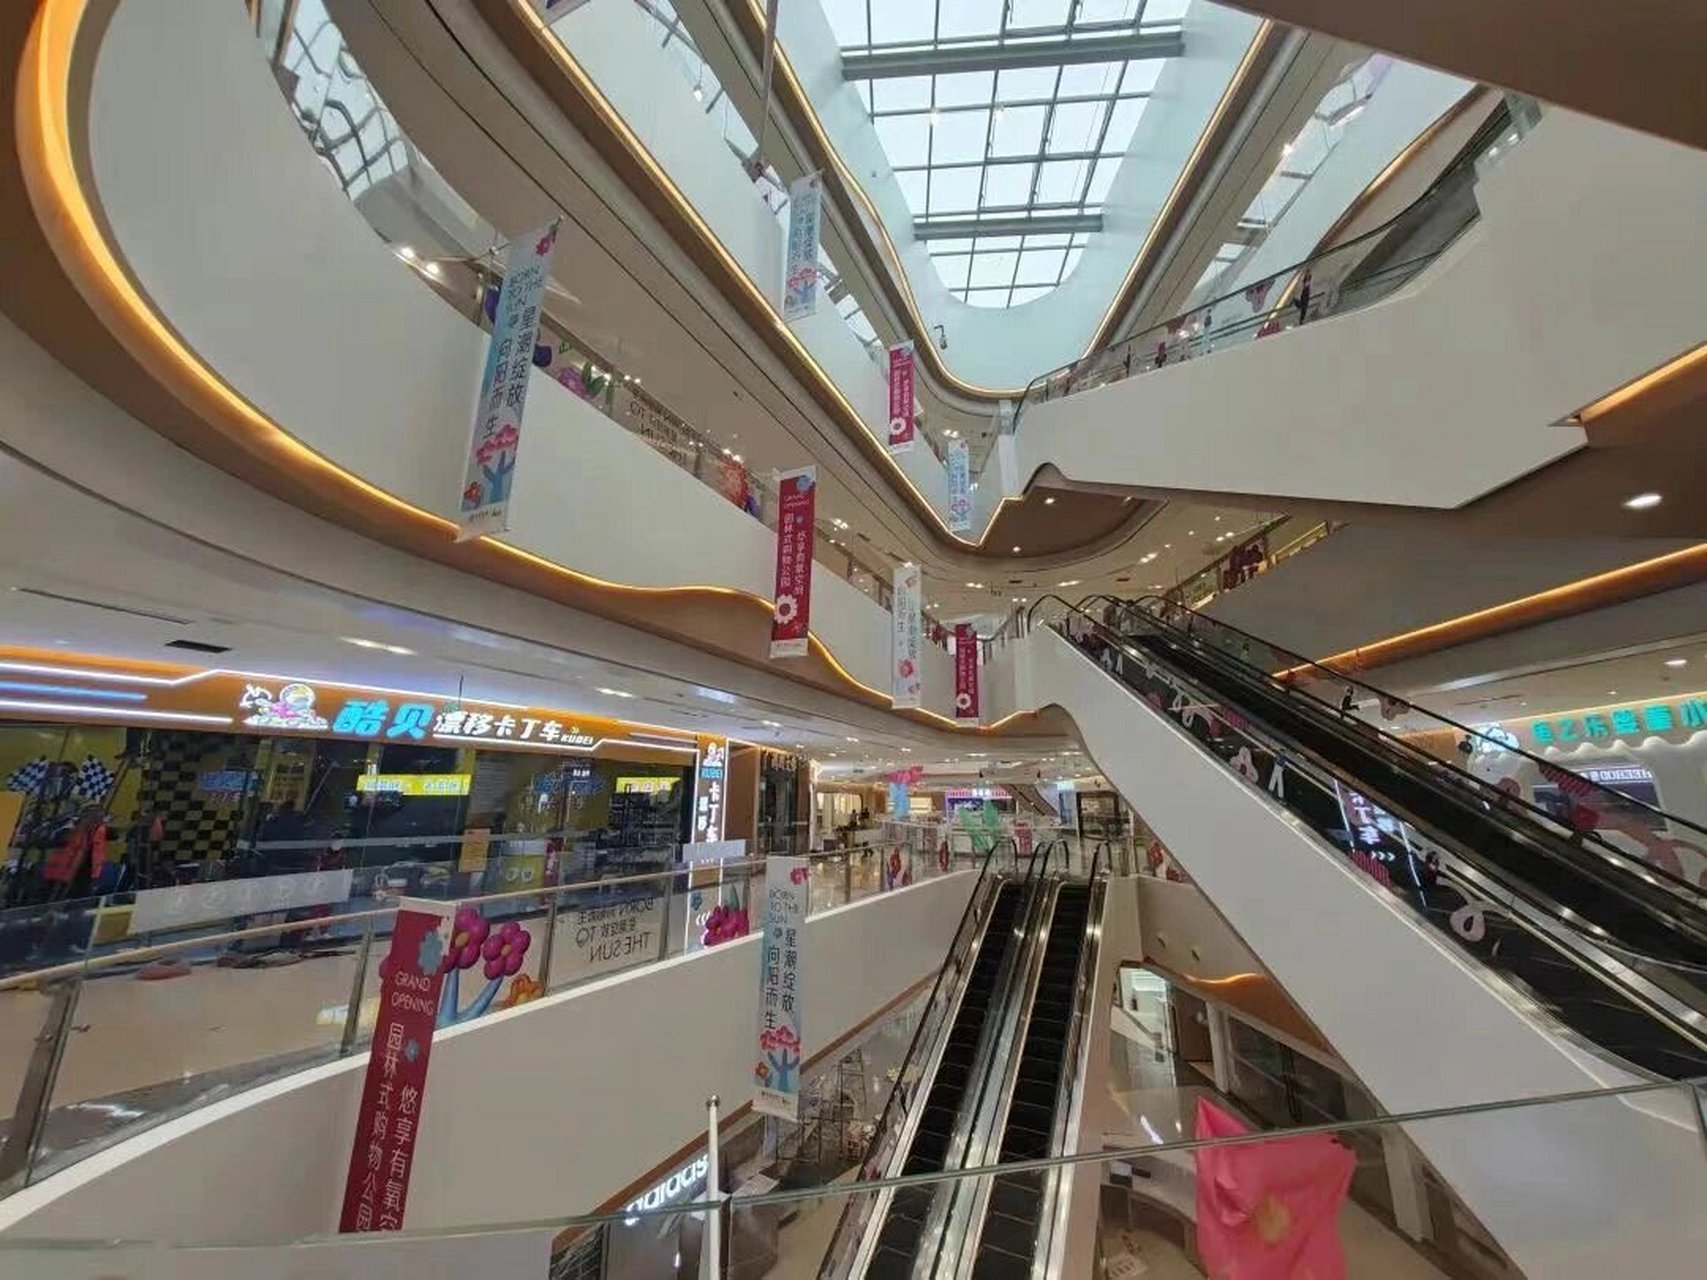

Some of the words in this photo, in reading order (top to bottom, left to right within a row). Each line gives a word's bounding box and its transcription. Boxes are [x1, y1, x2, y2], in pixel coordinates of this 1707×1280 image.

[483, 338, 513, 438] 向阳而生
[333, 699, 434, 740] 酷贝
[434, 710, 564, 742] 漂移卡丁车
[391, 992, 434, 1016] OPENING
[395, 971, 431, 992] GRAND
[765, 946, 781, 1030] 向阳而生
[356, 1022, 404, 1231] 园林式购物公园
[625, 1154, 709, 1226] adidas
